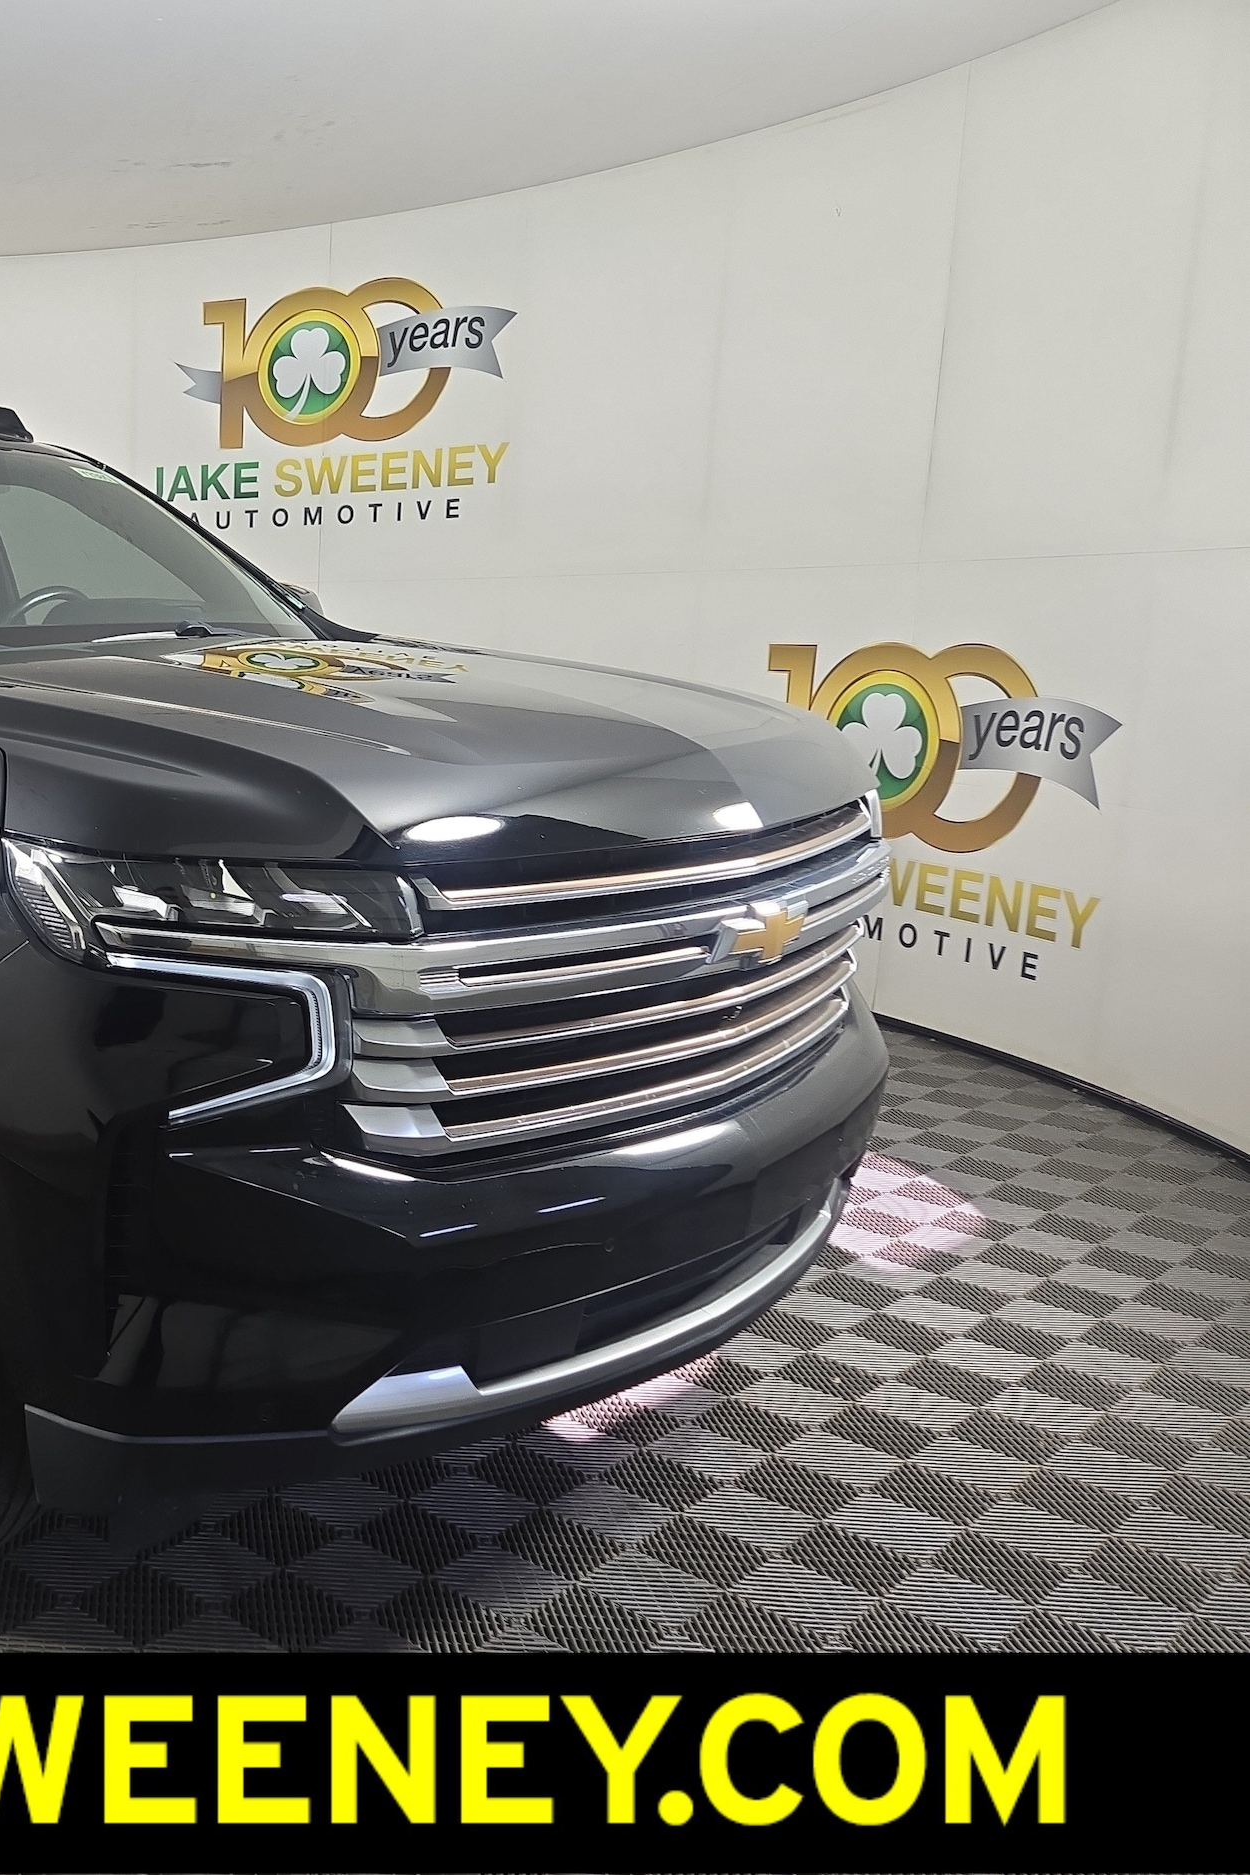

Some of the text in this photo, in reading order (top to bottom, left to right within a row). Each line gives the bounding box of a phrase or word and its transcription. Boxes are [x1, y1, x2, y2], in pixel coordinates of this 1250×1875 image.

[203, 277, 451, 449] 100
[386, 315, 486, 368] years
[155, 442, 510, 502] JAKE SWEENEY
[968, 709, 1086, 761] years
[889, 858, 1101, 949] WEENEY
[863, 915, 1039, 981] MOTIVE
